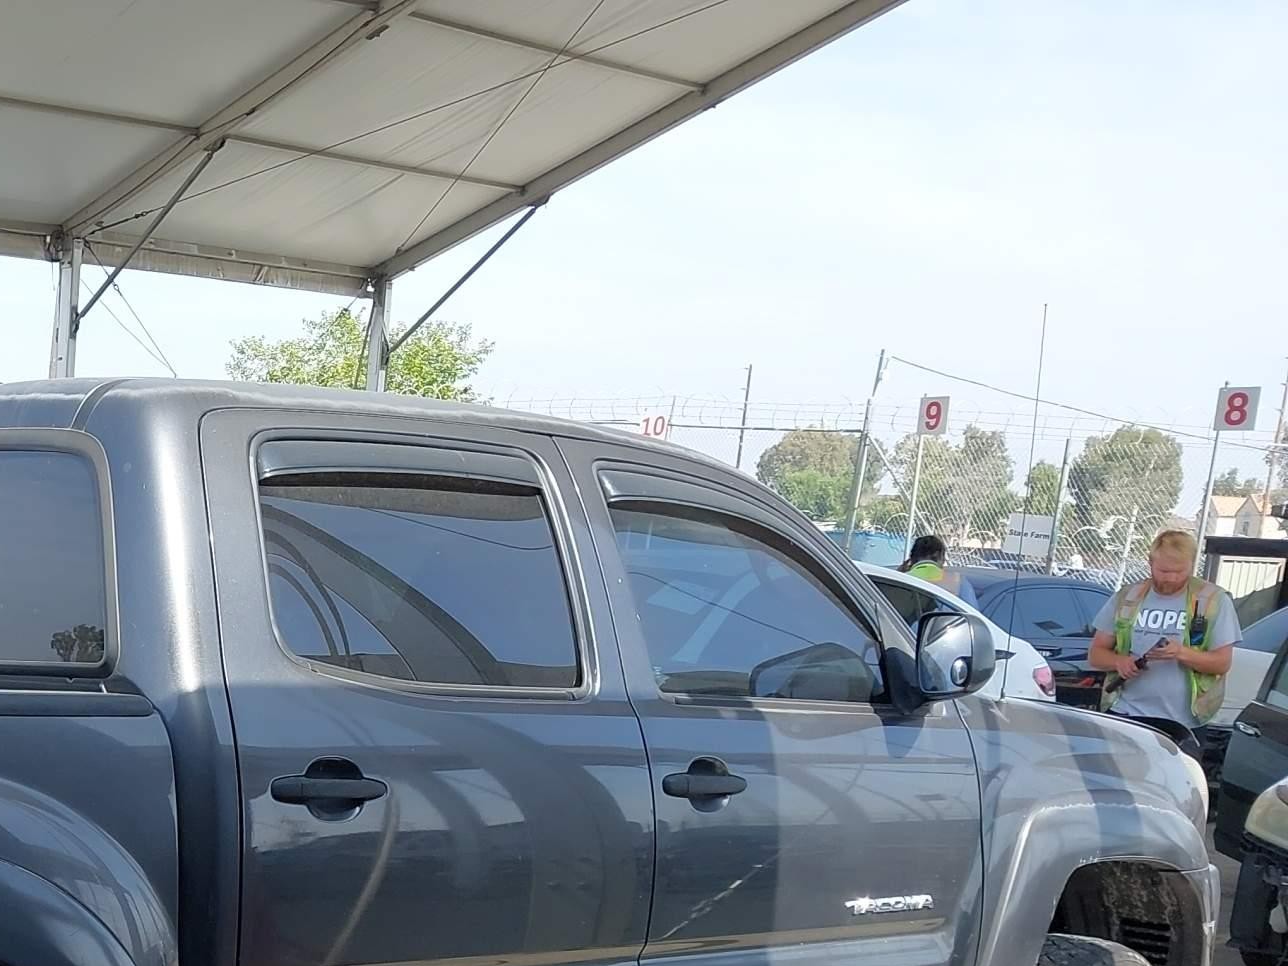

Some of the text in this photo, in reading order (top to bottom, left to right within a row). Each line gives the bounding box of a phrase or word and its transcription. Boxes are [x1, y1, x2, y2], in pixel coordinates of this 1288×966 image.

[925, 401, 942, 431] 9
[1224, 392, 1249, 426] 8
[642, 416, 666, 436] 10
[1030, 531, 1050, 539] Farm
[1133, 609, 1187, 630] NOPE
